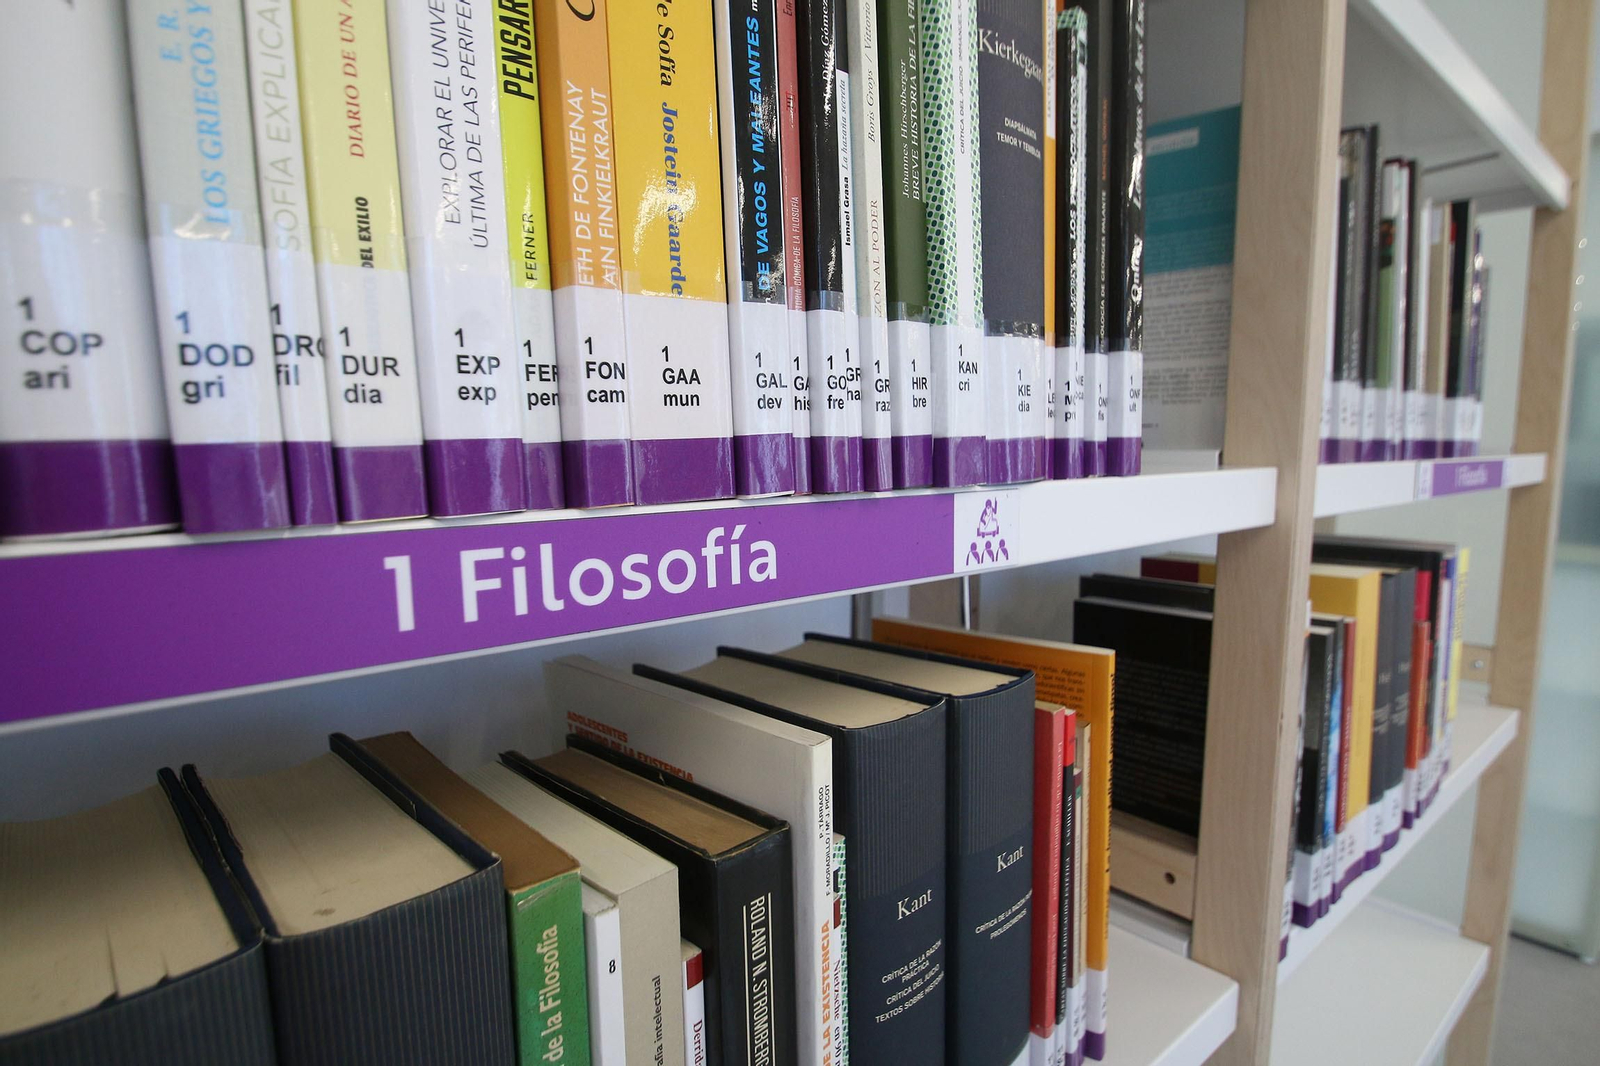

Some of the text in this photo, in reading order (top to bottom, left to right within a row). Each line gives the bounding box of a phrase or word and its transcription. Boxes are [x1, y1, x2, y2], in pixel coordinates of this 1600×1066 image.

[338, 12, 355, 43] UN
[498, 0, 535, 101] PENSAR
[657, 24, 677, 86] Sofía
[341, 50, 358, 77] DE
[863, 1, 877, 143] Boris Groys Vittorio
[188, 25, 227, 160] GRIEGOS
[433, 76, 452, 101] EL
[461, 85, 479, 130] LAS
[908, 24, 921, 201] BREVE HISTORIA DE LA
[257, 0, 299, 251] SOFÍA EXPLICA
[344, 85, 364, 158] DIARIO
[900, 58, 911, 199] Johannes Hirschberger
[464, 134, 483, 164] DE
[567, 80, 591, 206] FONTENAY
[996, 132, 1018, 148] TEMOR
[591, 88, 616, 242] FINKIELKRAUT
[746, 16, 771, 291] DE VAGOS Y MALEANTES
[842, 156, 849, 171] La
[434, 107, 461, 224] EXPLORAR
[202, 169, 230, 225] LOS
[356, 195, 371, 241] EXILIO
[466, 170, 489, 248] ÚLTIMA
[791, 195, 800, 233] FILOSOFÍA
[575, 210, 592, 240] DE
[522, 212, 538, 281] FERNER
[792, 235, 800, 244] LA
[870, 200, 881, 275] AL PODER
[1100, 284, 1106, 297] DE
[18, 297, 34, 321] 1
[270, 304, 282, 325] 1
[176, 311, 190, 334] 1
[20, 330, 103, 356] COP
[339, 327, 351, 347] 1
[454, 328, 464, 348] 1
[523, 339, 532, 357] 1
[584, 336, 593, 355] 1
[178, 343, 255, 367] DOD
[661, 345, 669, 362] 1
[755, 352, 761, 368] 1
[845, 348, 850, 362] 1
[958, 344, 963, 356] 1
[342, 355, 400, 377] DUR
[456, 354, 500, 375] EXP
[585, 361, 626, 380] FON
[793, 356, 800, 371] 1
[827, 355, 833, 370] 1
[874, 360, 880, 373] 1
[911, 359, 916, 372] 1
[958, 361, 978, 374] KAN
[23, 365, 71, 390] ari
[275, 364, 301, 386] fil
[662, 367, 701, 385] GAA
[756, 373, 788, 389] GAL
[912, 377, 928, 390] HIR
[958, 379, 970, 391] cri
[1017, 369, 1022, 381] 1
[182, 375, 225, 404] gri
[344, 383, 382, 404] dia
[457, 385, 497, 406] exp
[587, 389, 625, 403] cam
[663, 393, 700, 407] mun
[1018, 385, 1031, 397] KIE
[757, 394, 782, 410] dev
[827, 394, 845, 409] fre
[912, 395, 927, 408] bre
[1018, 401, 1030, 412] dia
[383, 523, 779, 633] 1 Filosofía
[996, 846, 1024, 873] Kant
[897, 888, 932, 921] Kant
[750, 895, 766, 961] ROLAND
[608, 960, 616, 974] 8
[881, 954, 926, 984] CRÍTICA DE LA
[821, 920, 832, 1050] LA EXISTENCIA
[886, 963, 940, 1005] CRÍTICA DEL JUICIO
[651, 974, 663, 1044] intelectual
[875, 990, 925, 1023] TEXTOS SOBRE
[541, 1011, 564, 1062] de la
[834, 1026, 841, 1041] en
